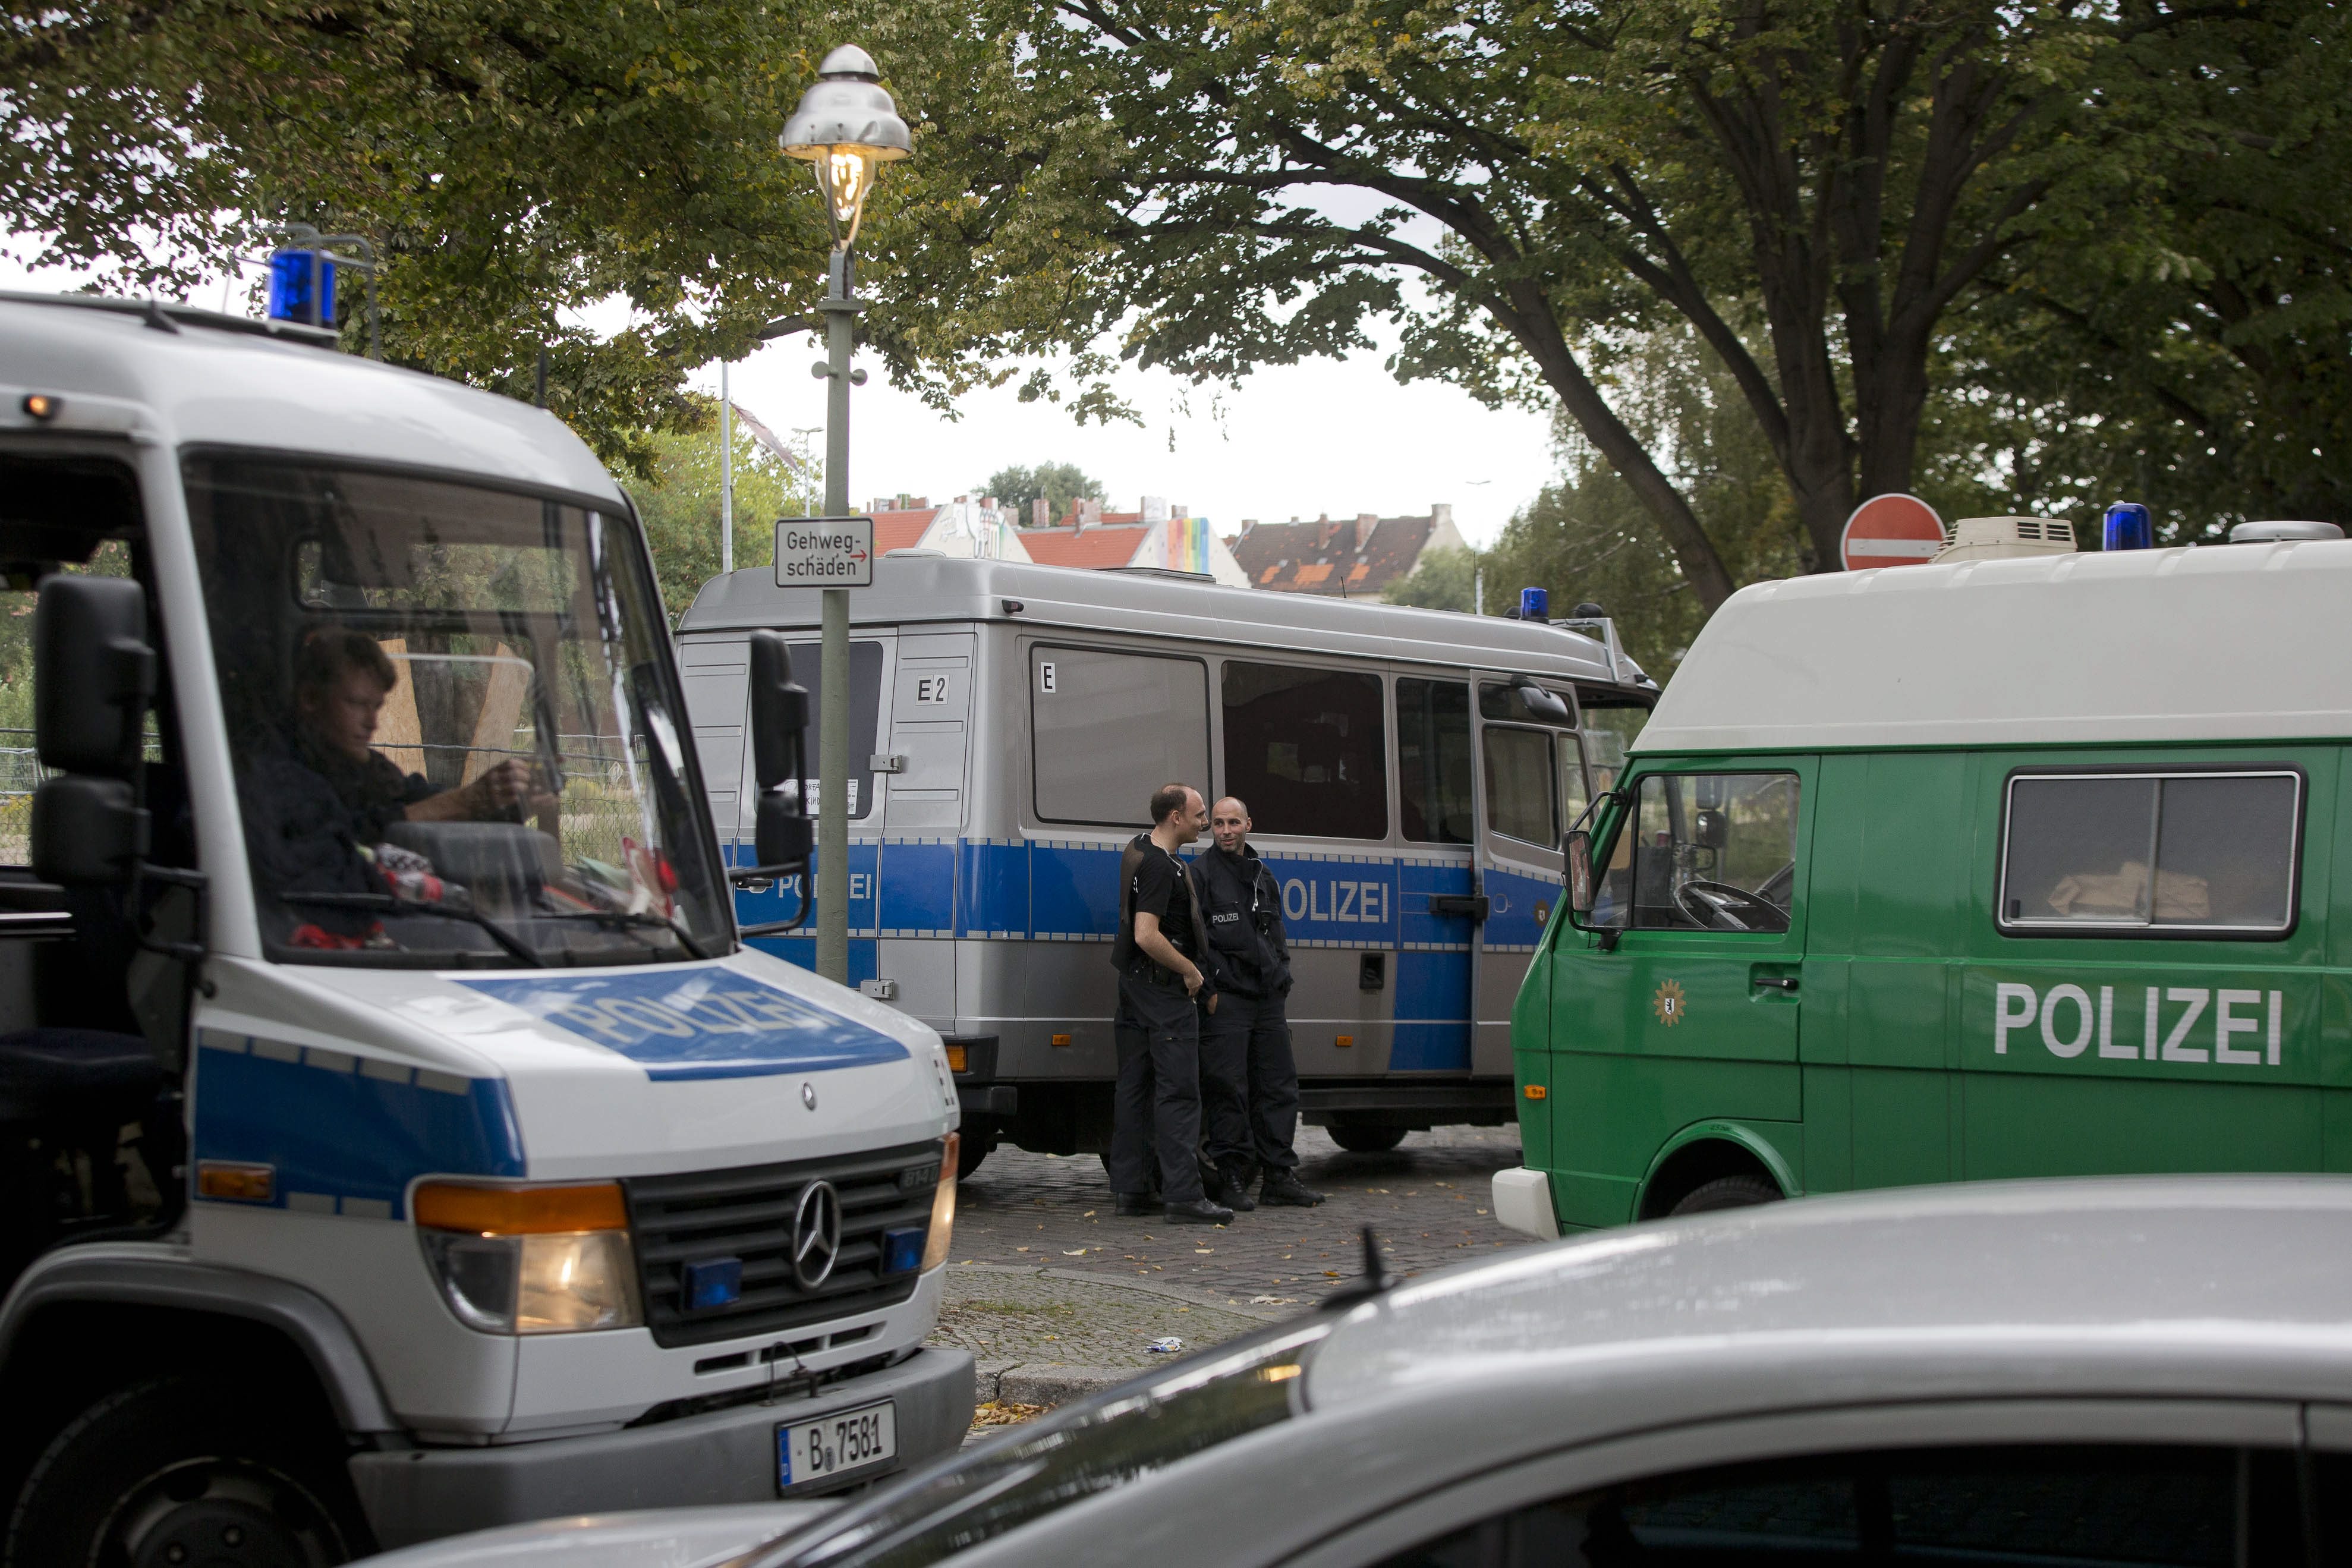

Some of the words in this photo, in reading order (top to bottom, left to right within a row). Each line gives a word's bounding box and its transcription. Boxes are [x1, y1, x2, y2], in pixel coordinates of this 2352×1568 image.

[788, 531, 861, 553] Gehweg-
[787, 558, 857, 576] schäden
[1043, 665, 1053, 689] E
[1213, 912, 1239, 923] POLIZEI
[1276, 879, 1388, 923] OLIZEI
[561, 990, 843, 1044] POLIZEI
[1994, 983, 2282, 1066] POLIZEI
[810, 1428, 824, 1471] B
[836, 1413, 883, 1464] 7581
